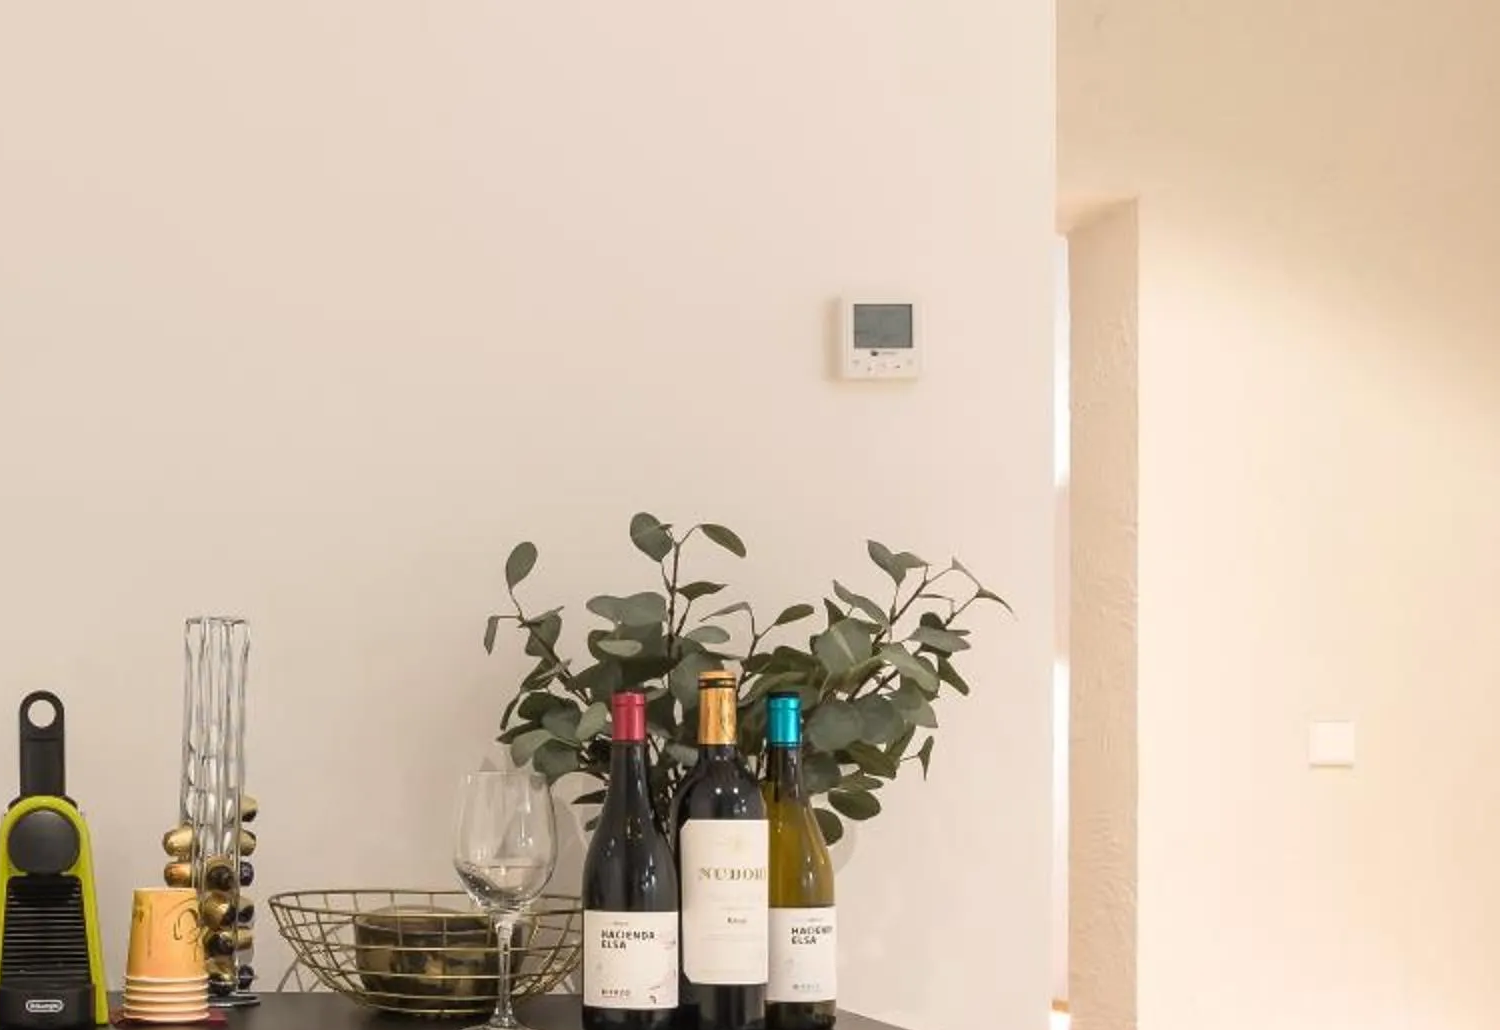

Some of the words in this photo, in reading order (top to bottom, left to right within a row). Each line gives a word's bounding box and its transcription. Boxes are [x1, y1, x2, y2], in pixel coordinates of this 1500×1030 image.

[601, 929, 655, 940] HACIENDA
[601, 940, 627, 949] ELSA
[791, 935, 818, 945] ELSA
